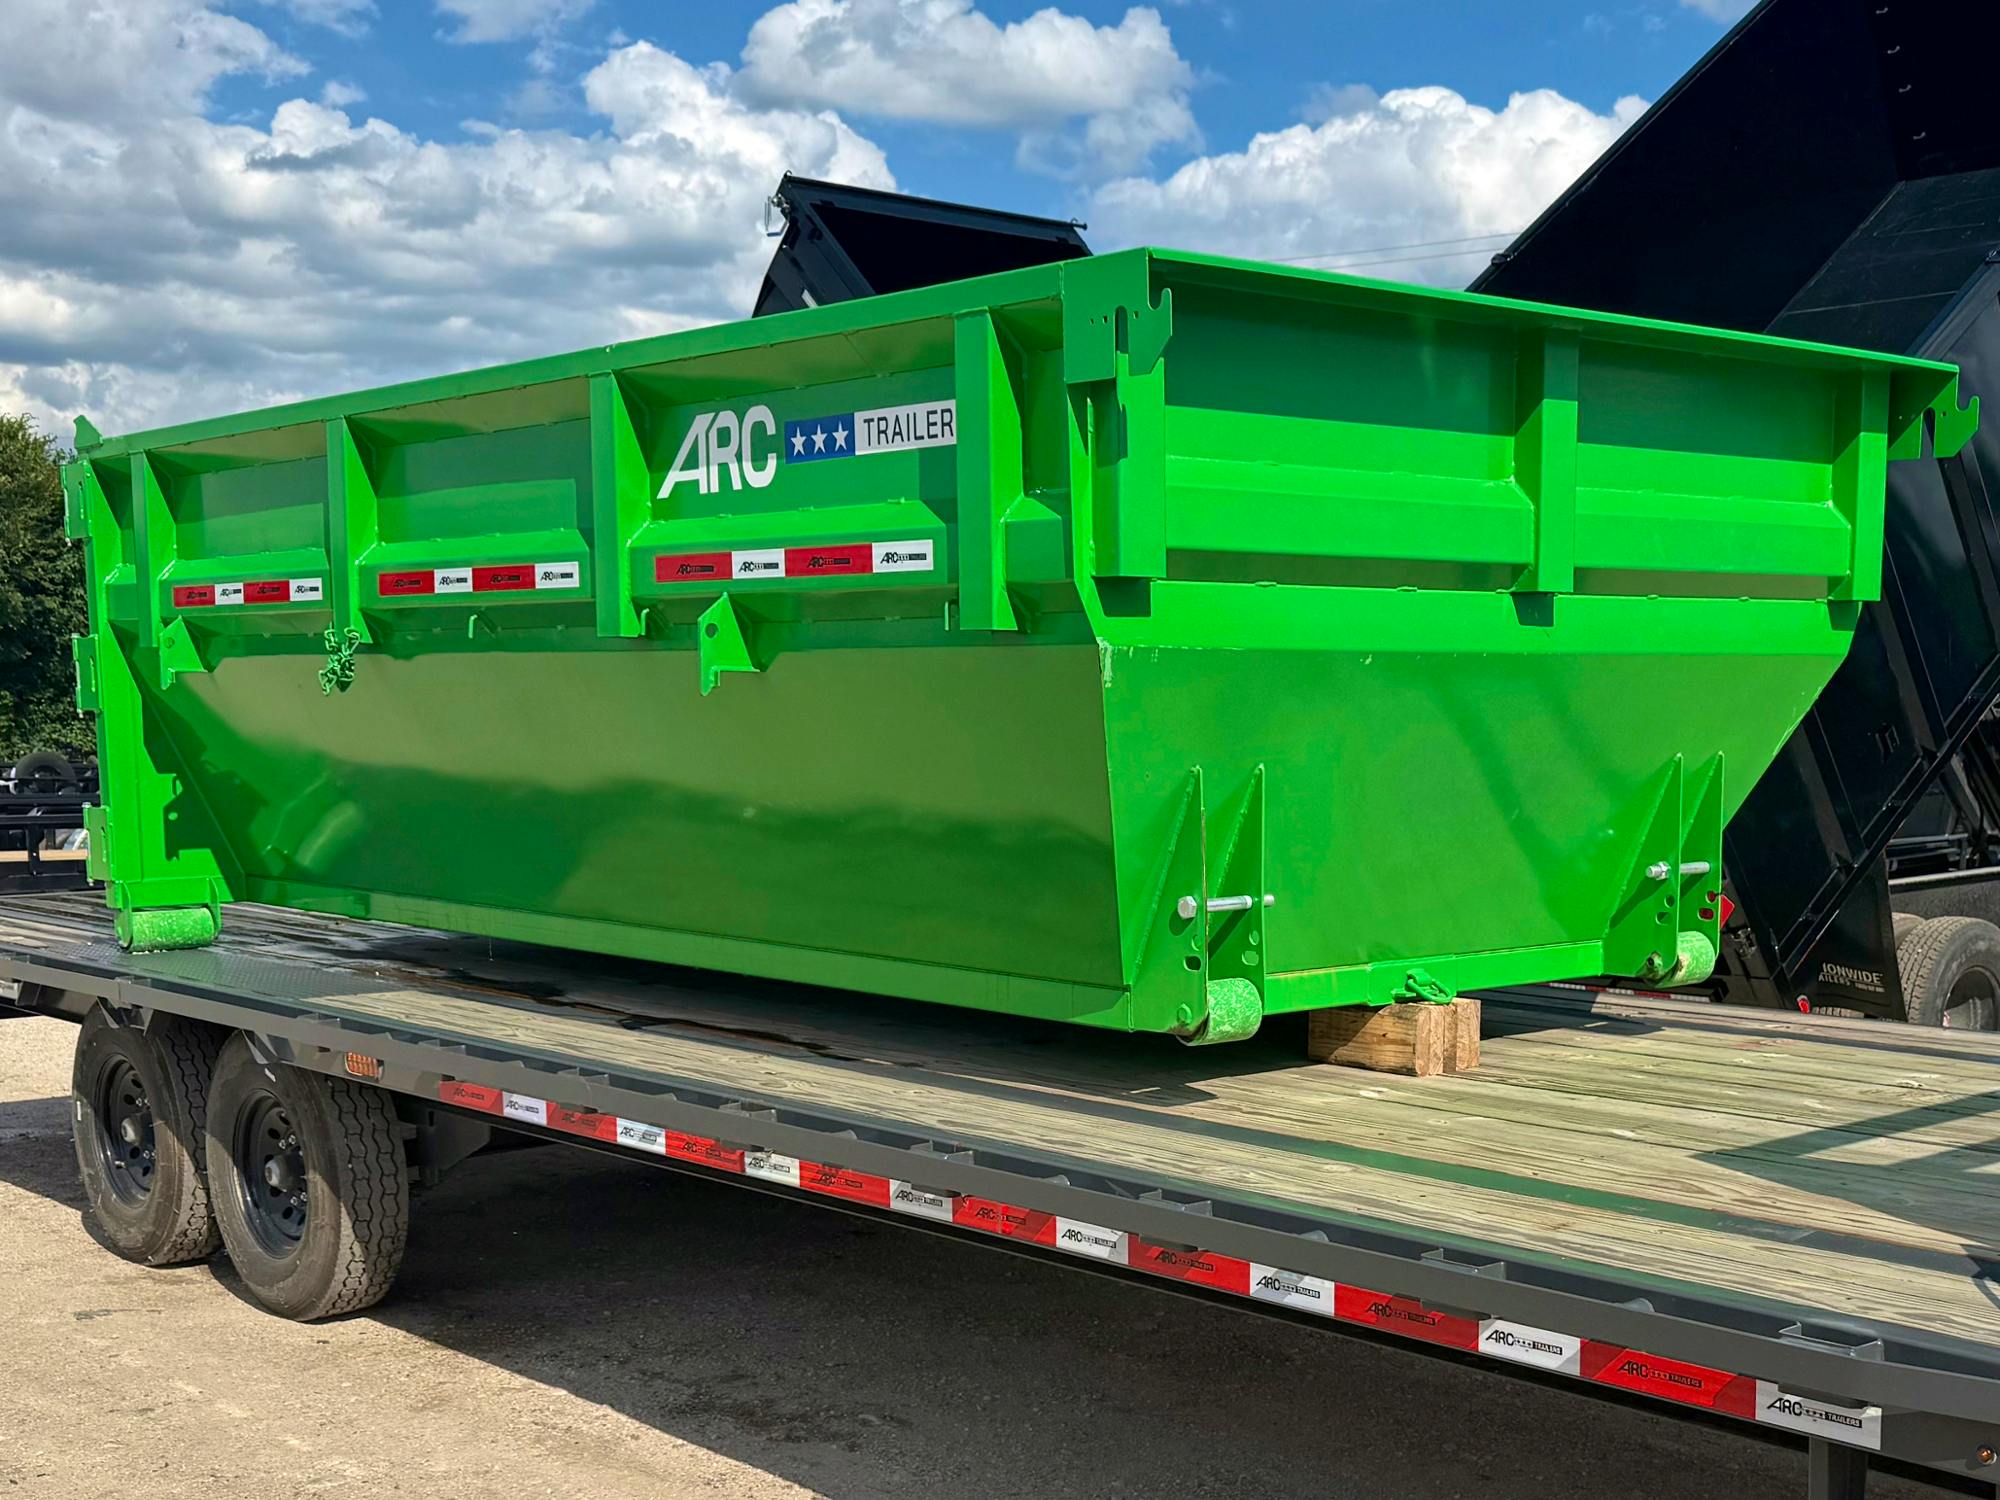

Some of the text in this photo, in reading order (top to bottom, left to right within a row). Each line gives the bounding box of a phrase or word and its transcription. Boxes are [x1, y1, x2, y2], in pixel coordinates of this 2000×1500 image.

[656, 404, 777, 499] ARC
[880, 551, 899, 564] ARC
[1061, 1229, 1083, 1243] ARC
[1256, 1276, 1281, 1291] ARC
[1486, 1329, 1515, 1346] ARC
[1617, 1360, 1650, 1379] ARC
[1766, 1397, 1803, 1417] ARC
